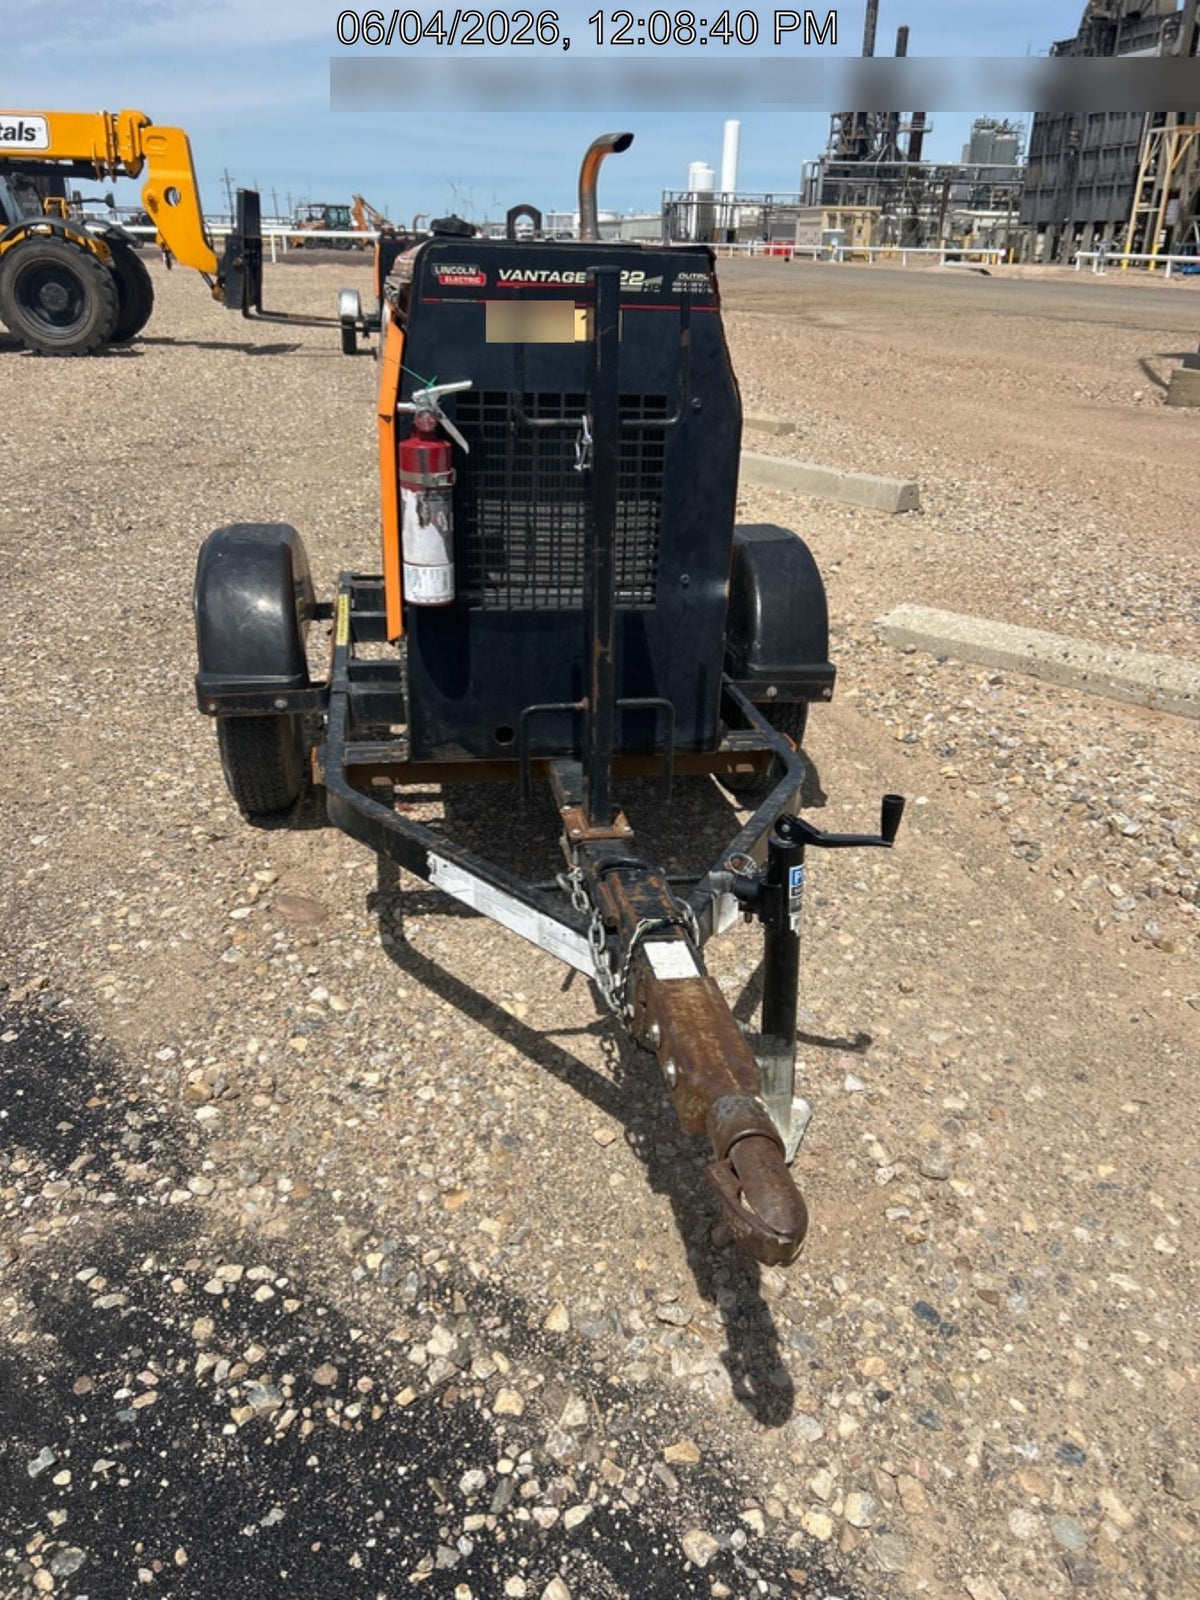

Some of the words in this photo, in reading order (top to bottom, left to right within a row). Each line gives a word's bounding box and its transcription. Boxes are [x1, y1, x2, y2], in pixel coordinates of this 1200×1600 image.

[434, 266, 477, 275] LINCOLN
[444, 275, 482, 285] ELECTRIC
[498, 268, 587, 284] VANTAGE
